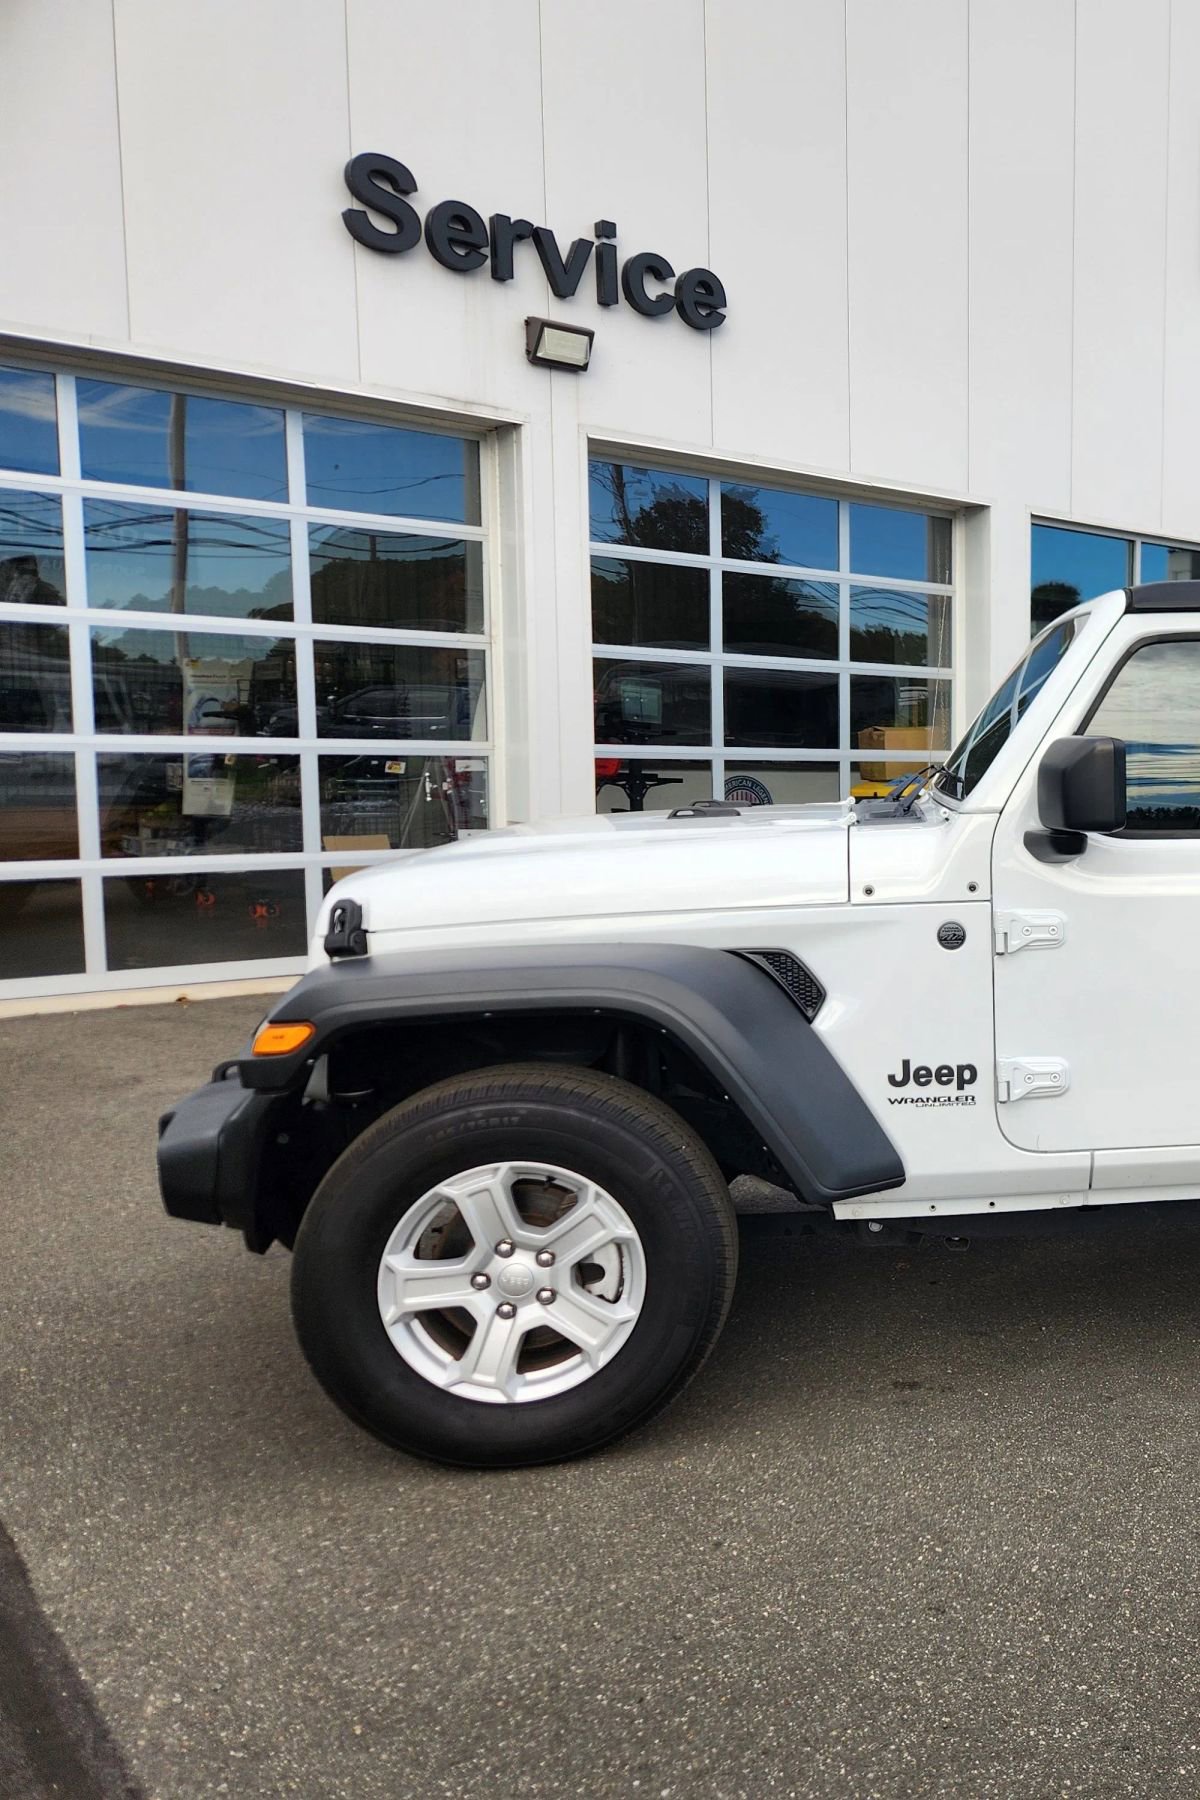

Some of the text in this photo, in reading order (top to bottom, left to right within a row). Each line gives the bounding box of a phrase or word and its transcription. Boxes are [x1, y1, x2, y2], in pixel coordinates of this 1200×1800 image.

[341, 151, 727, 330] Service
[887, 1059, 978, 1091] Jeep
[887, 1095, 976, 1105] WRANGLER
